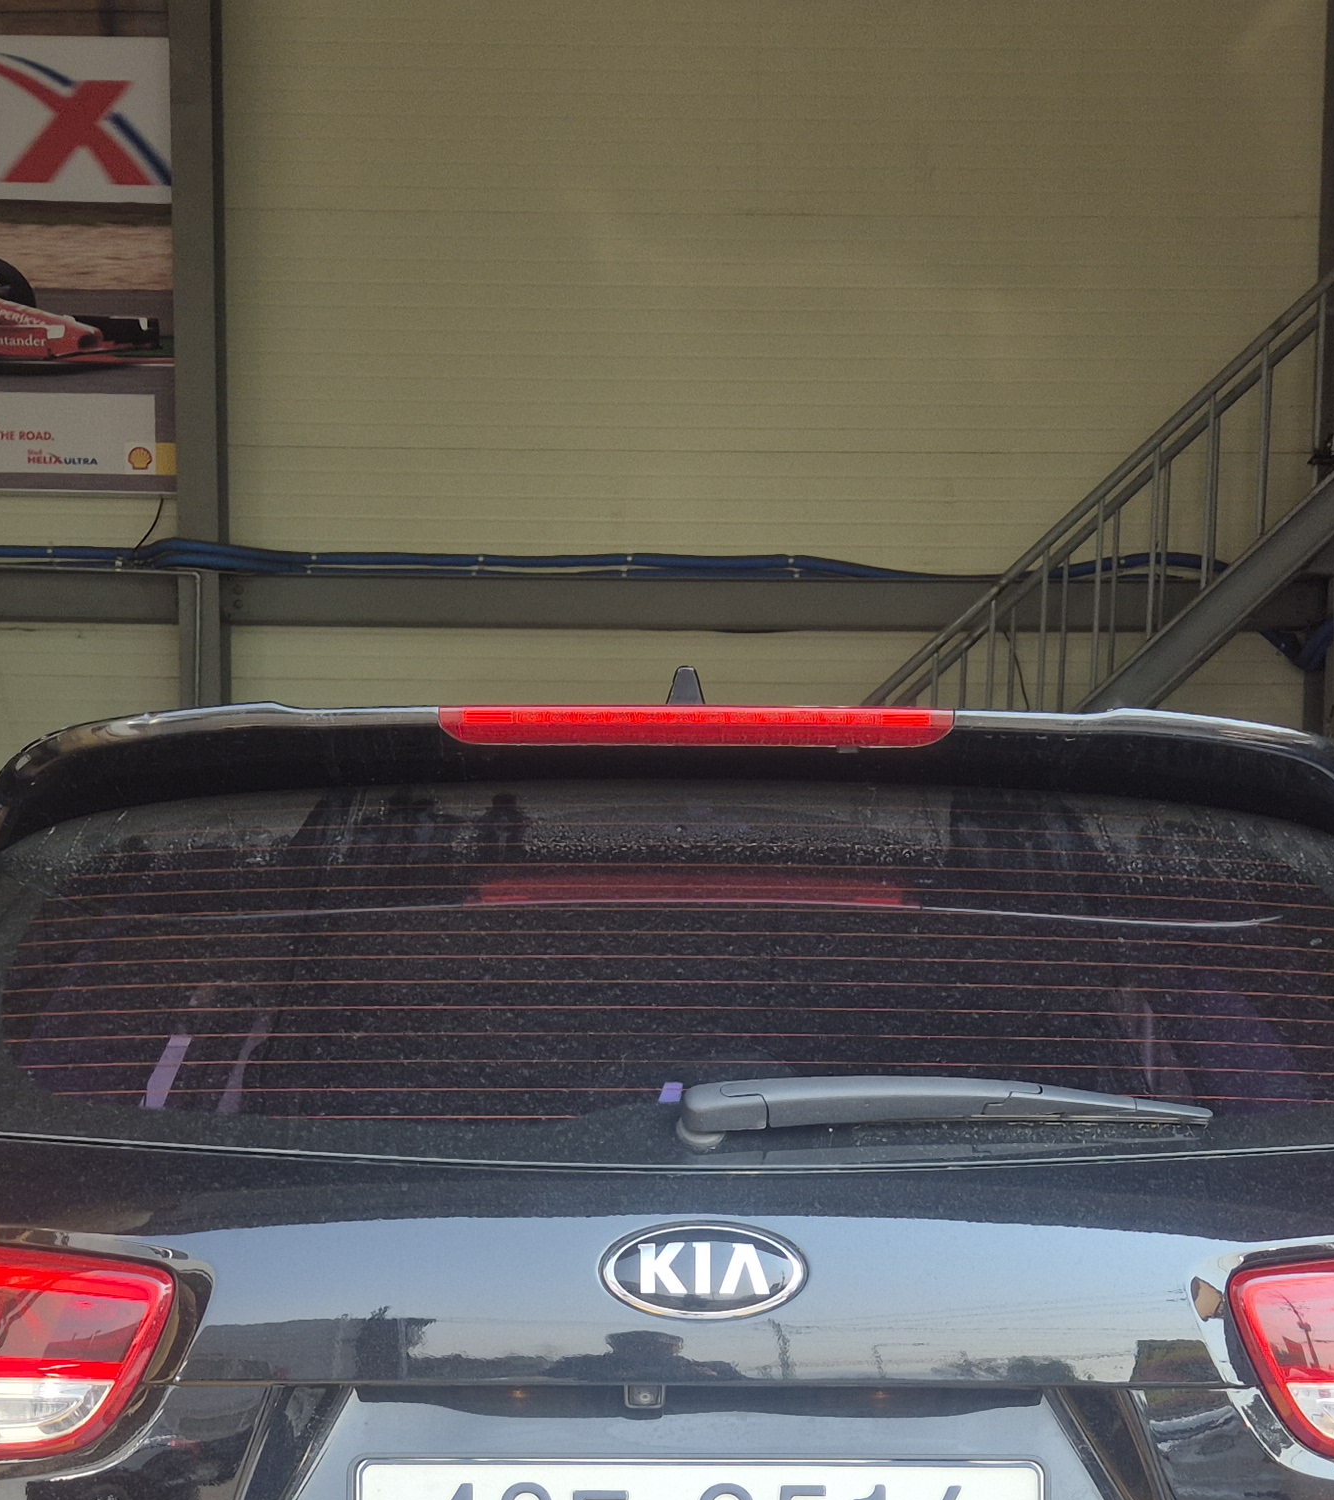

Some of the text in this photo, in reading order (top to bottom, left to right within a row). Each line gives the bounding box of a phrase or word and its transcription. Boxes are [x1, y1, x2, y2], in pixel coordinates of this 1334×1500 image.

[18, 431, 55, 442] ROAD.
[64, 457, 98, 466] ULTRA
[638, 1241, 771, 1295] KIA
